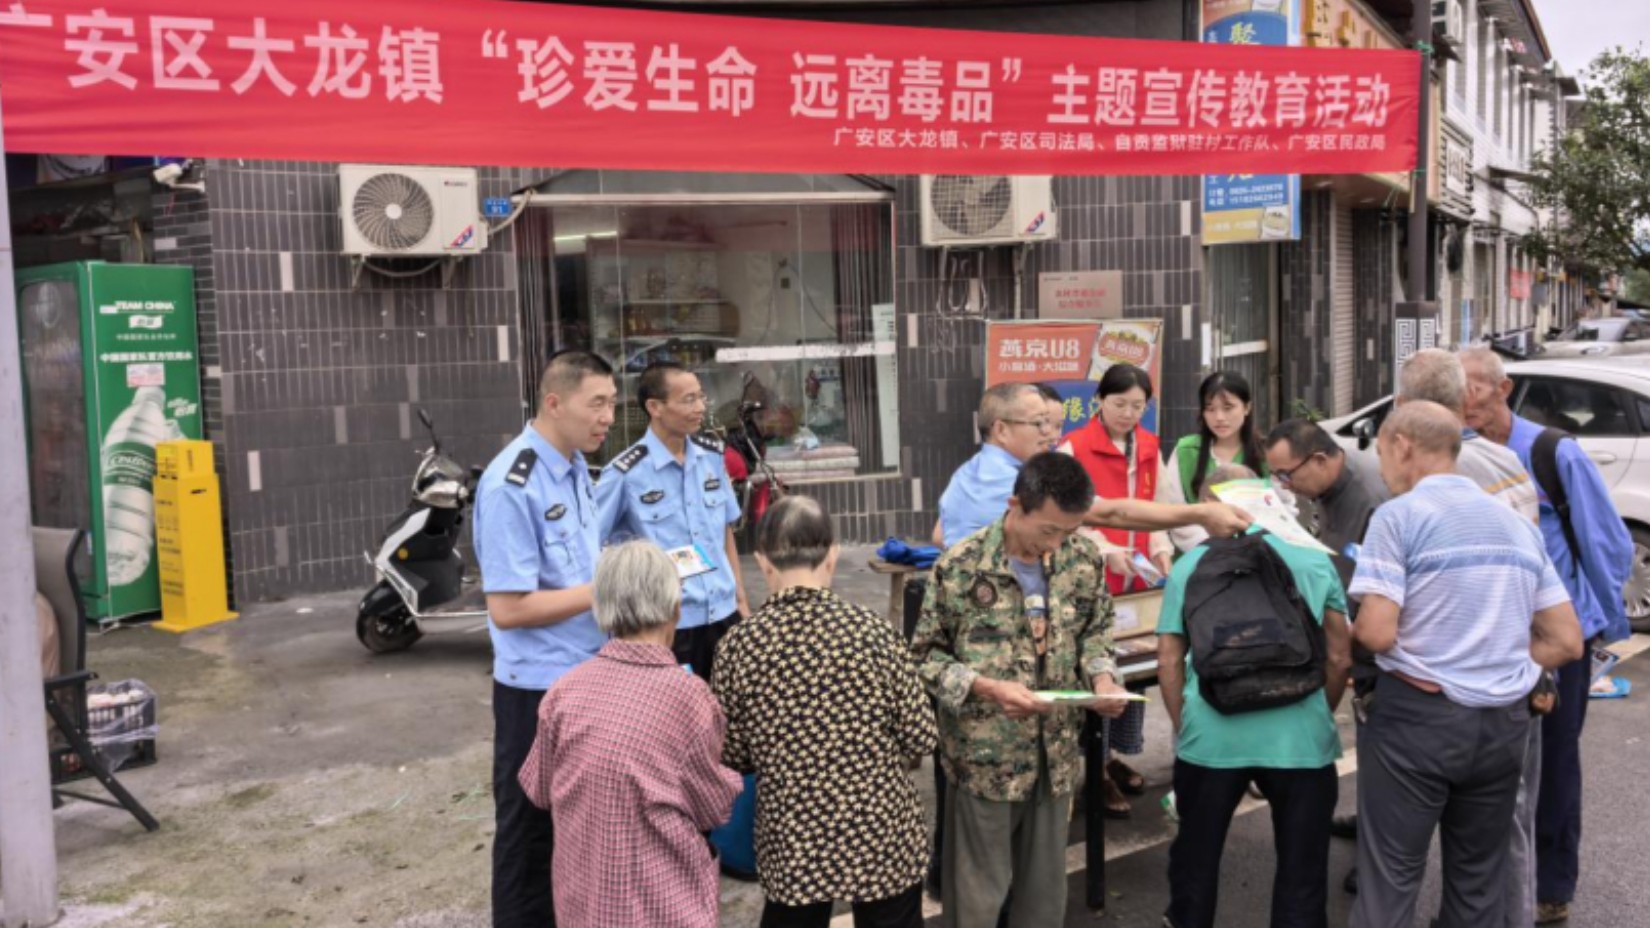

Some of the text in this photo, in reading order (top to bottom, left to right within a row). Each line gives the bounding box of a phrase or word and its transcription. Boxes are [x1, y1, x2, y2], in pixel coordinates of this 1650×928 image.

[1047, 64, 1390, 128] 主题宣传教育活动
[998, 338, 1080, 359] 燕京U8
